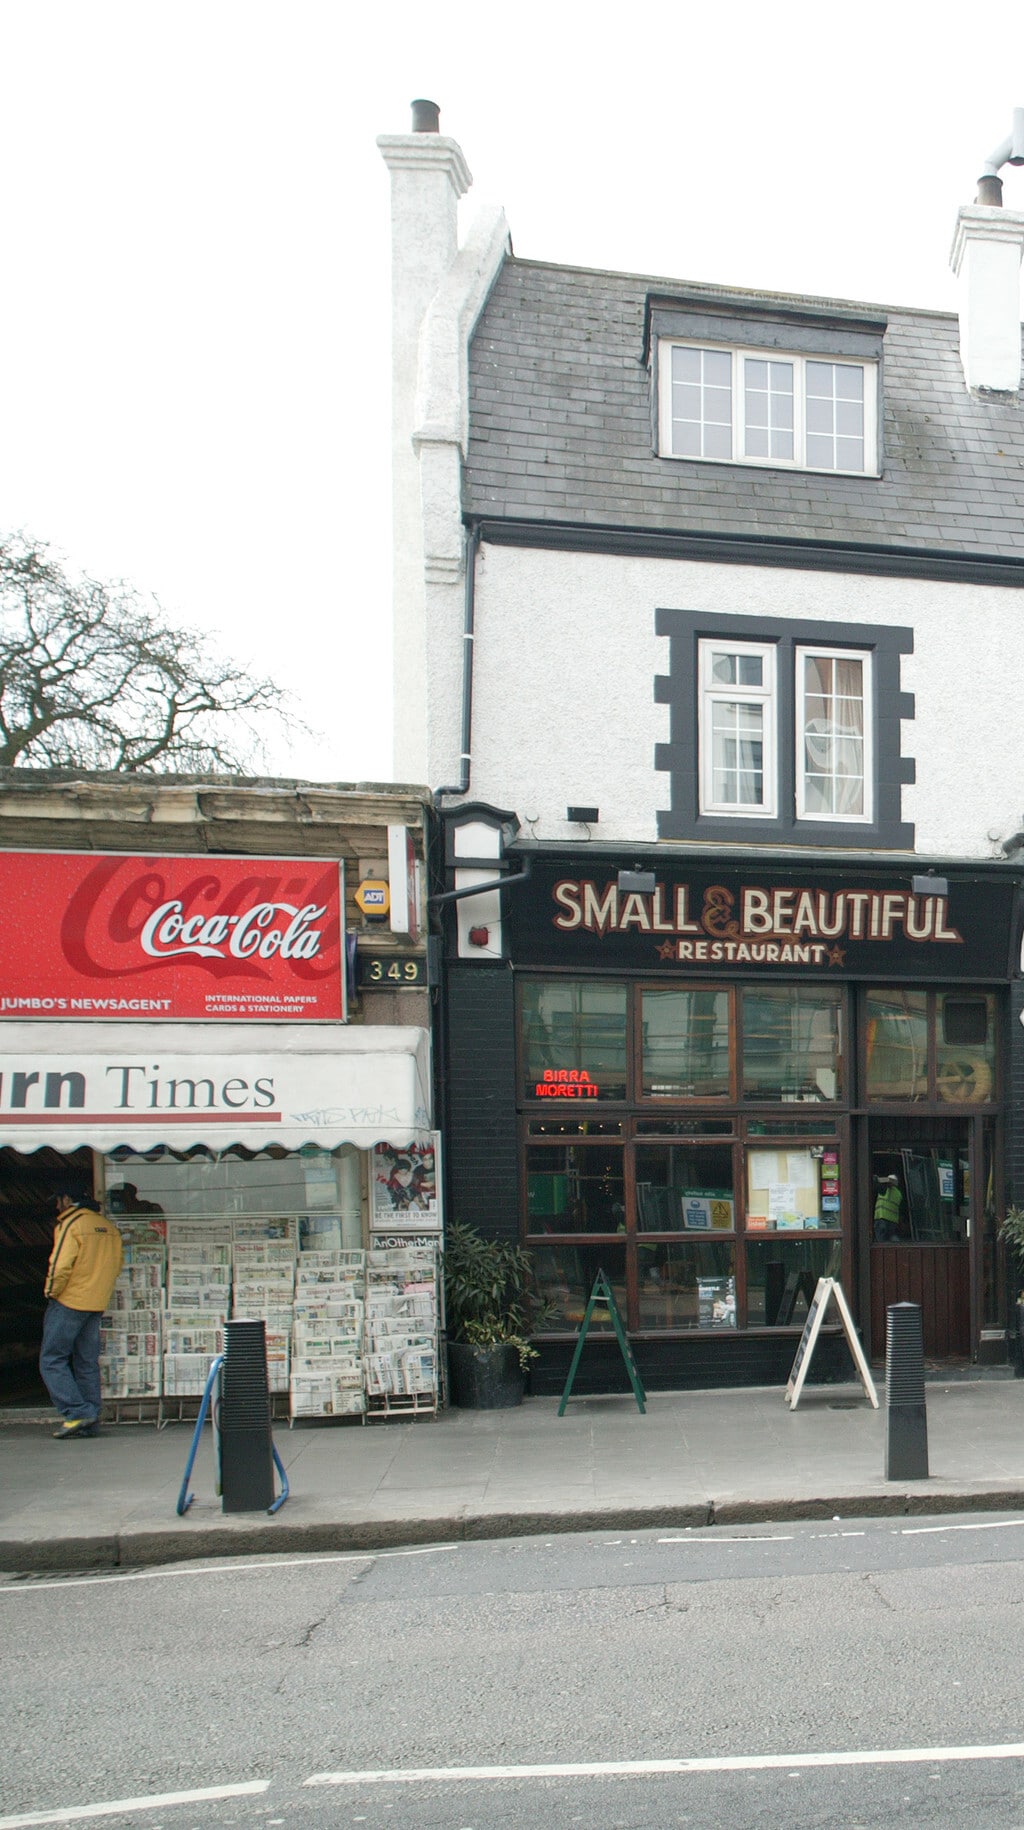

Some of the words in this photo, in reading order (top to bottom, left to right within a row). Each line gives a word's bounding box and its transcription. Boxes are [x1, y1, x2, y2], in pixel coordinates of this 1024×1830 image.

[363, 890, 384, 903] ADT
[555, 882, 700, 933] SMALL
[743, 888, 959, 940] BEAUTIFUL
[141, 900, 327, 959] Coca-Cola
[678, 942, 825, 963] RESTAURANT
[370, 961, 418, 980] 349
[0, 998, 67, 1010] JUMBO'S
[70, 998, 171, 1011] NEWSAGENT
[204, 994, 281, 1004] INTERNATIONAL
[283, 995, 317, 1004] PAPERS
[204, 1004, 237, 1013] CARDS
[239, 1005, 246, 1013] &
[247, 1004, 304, 1013] STATIONERY
[543, 1069, 590, 1083] BIRRA
[0, 1071, 86, 1108] rn
[105, 1065, 276, 1108] Times
[536, 1083, 598, 1098] MORETTI
[373, 1237, 440, 1249] AnOtherMan
